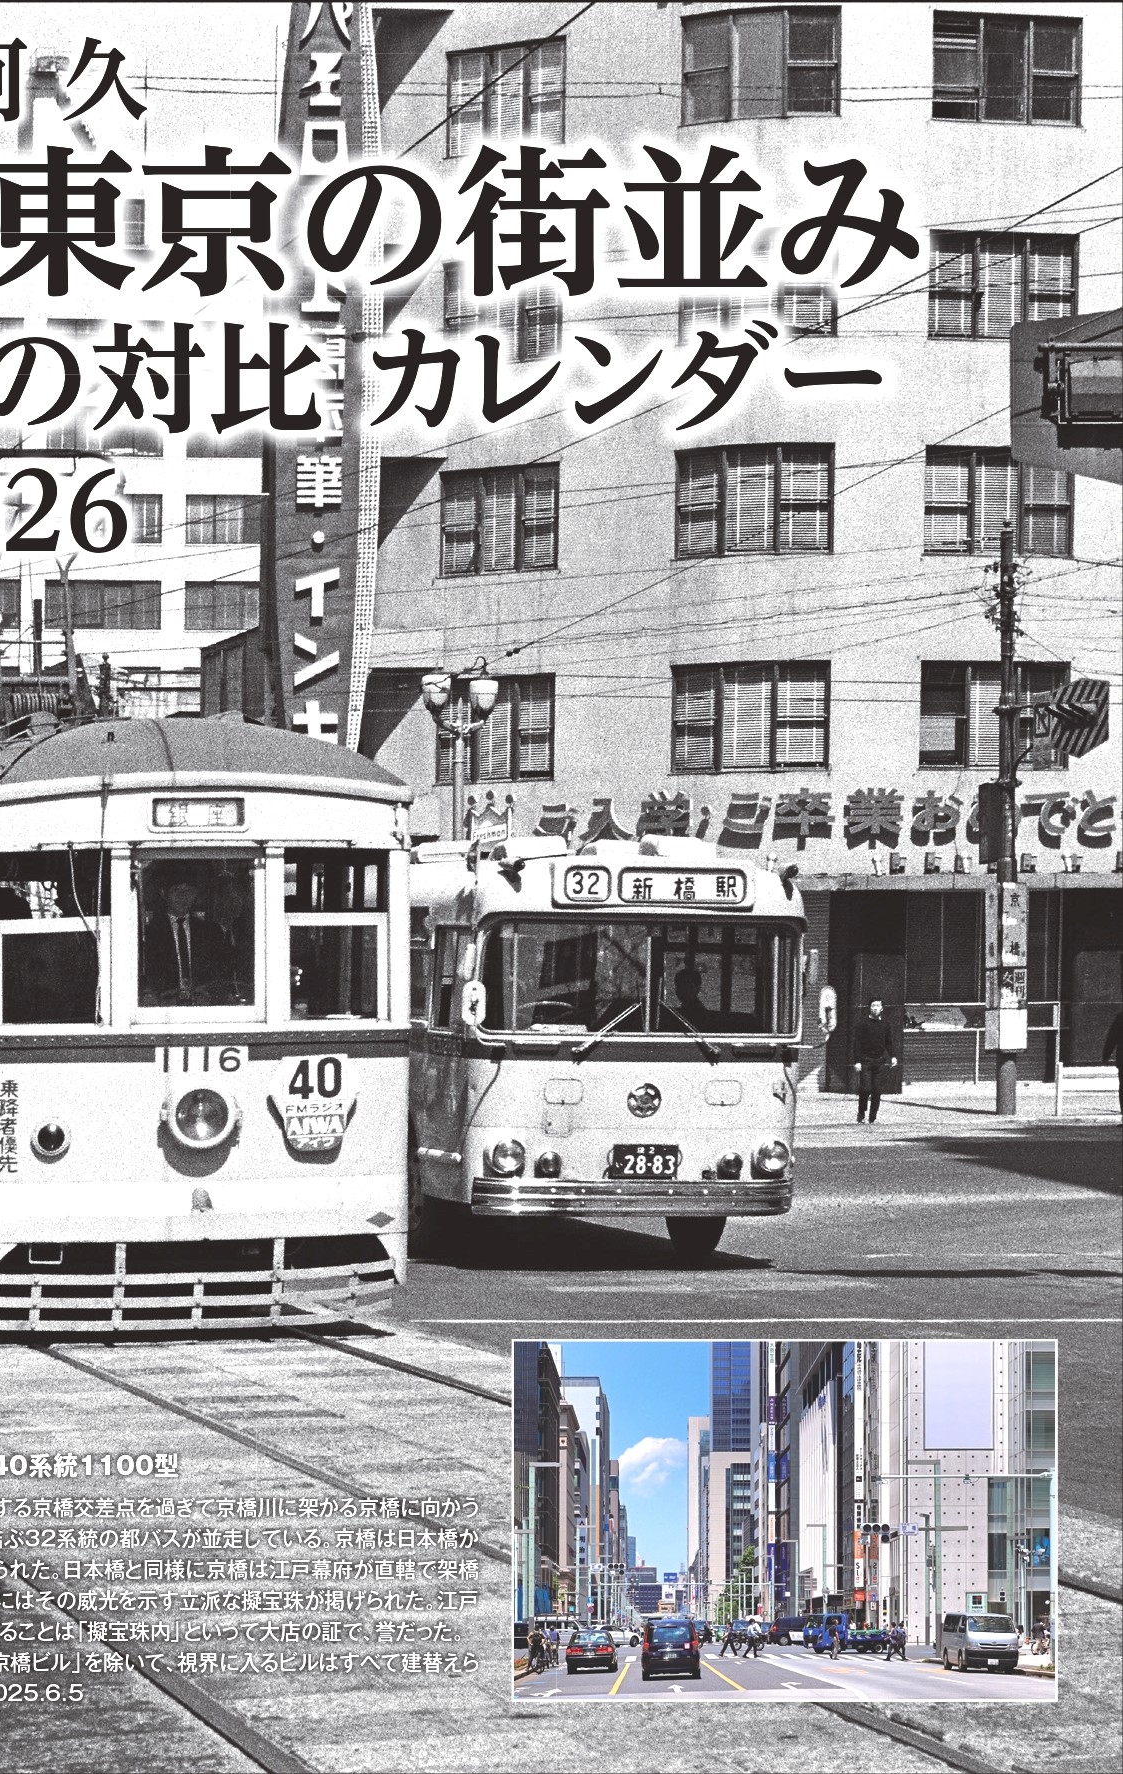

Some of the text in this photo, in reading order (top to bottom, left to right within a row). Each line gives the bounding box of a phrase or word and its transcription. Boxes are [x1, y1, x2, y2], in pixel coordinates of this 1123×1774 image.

[167, 803, 237, 828] 銀座
[531, 786, 1118, 848] ご入学・ご卒業おでと
[571, 871, 601, 896] 32
[631, 874, 738, 900] 新橋駅
[162, 1047, 242, 1073] 1116
[288, 1056, 342, 1100] 40
[285, 1102, 344, 1114] FMラジオ
[287, 1115, 344, 1136] AIWA
[623, 1154, 676, 1174] 28-83
